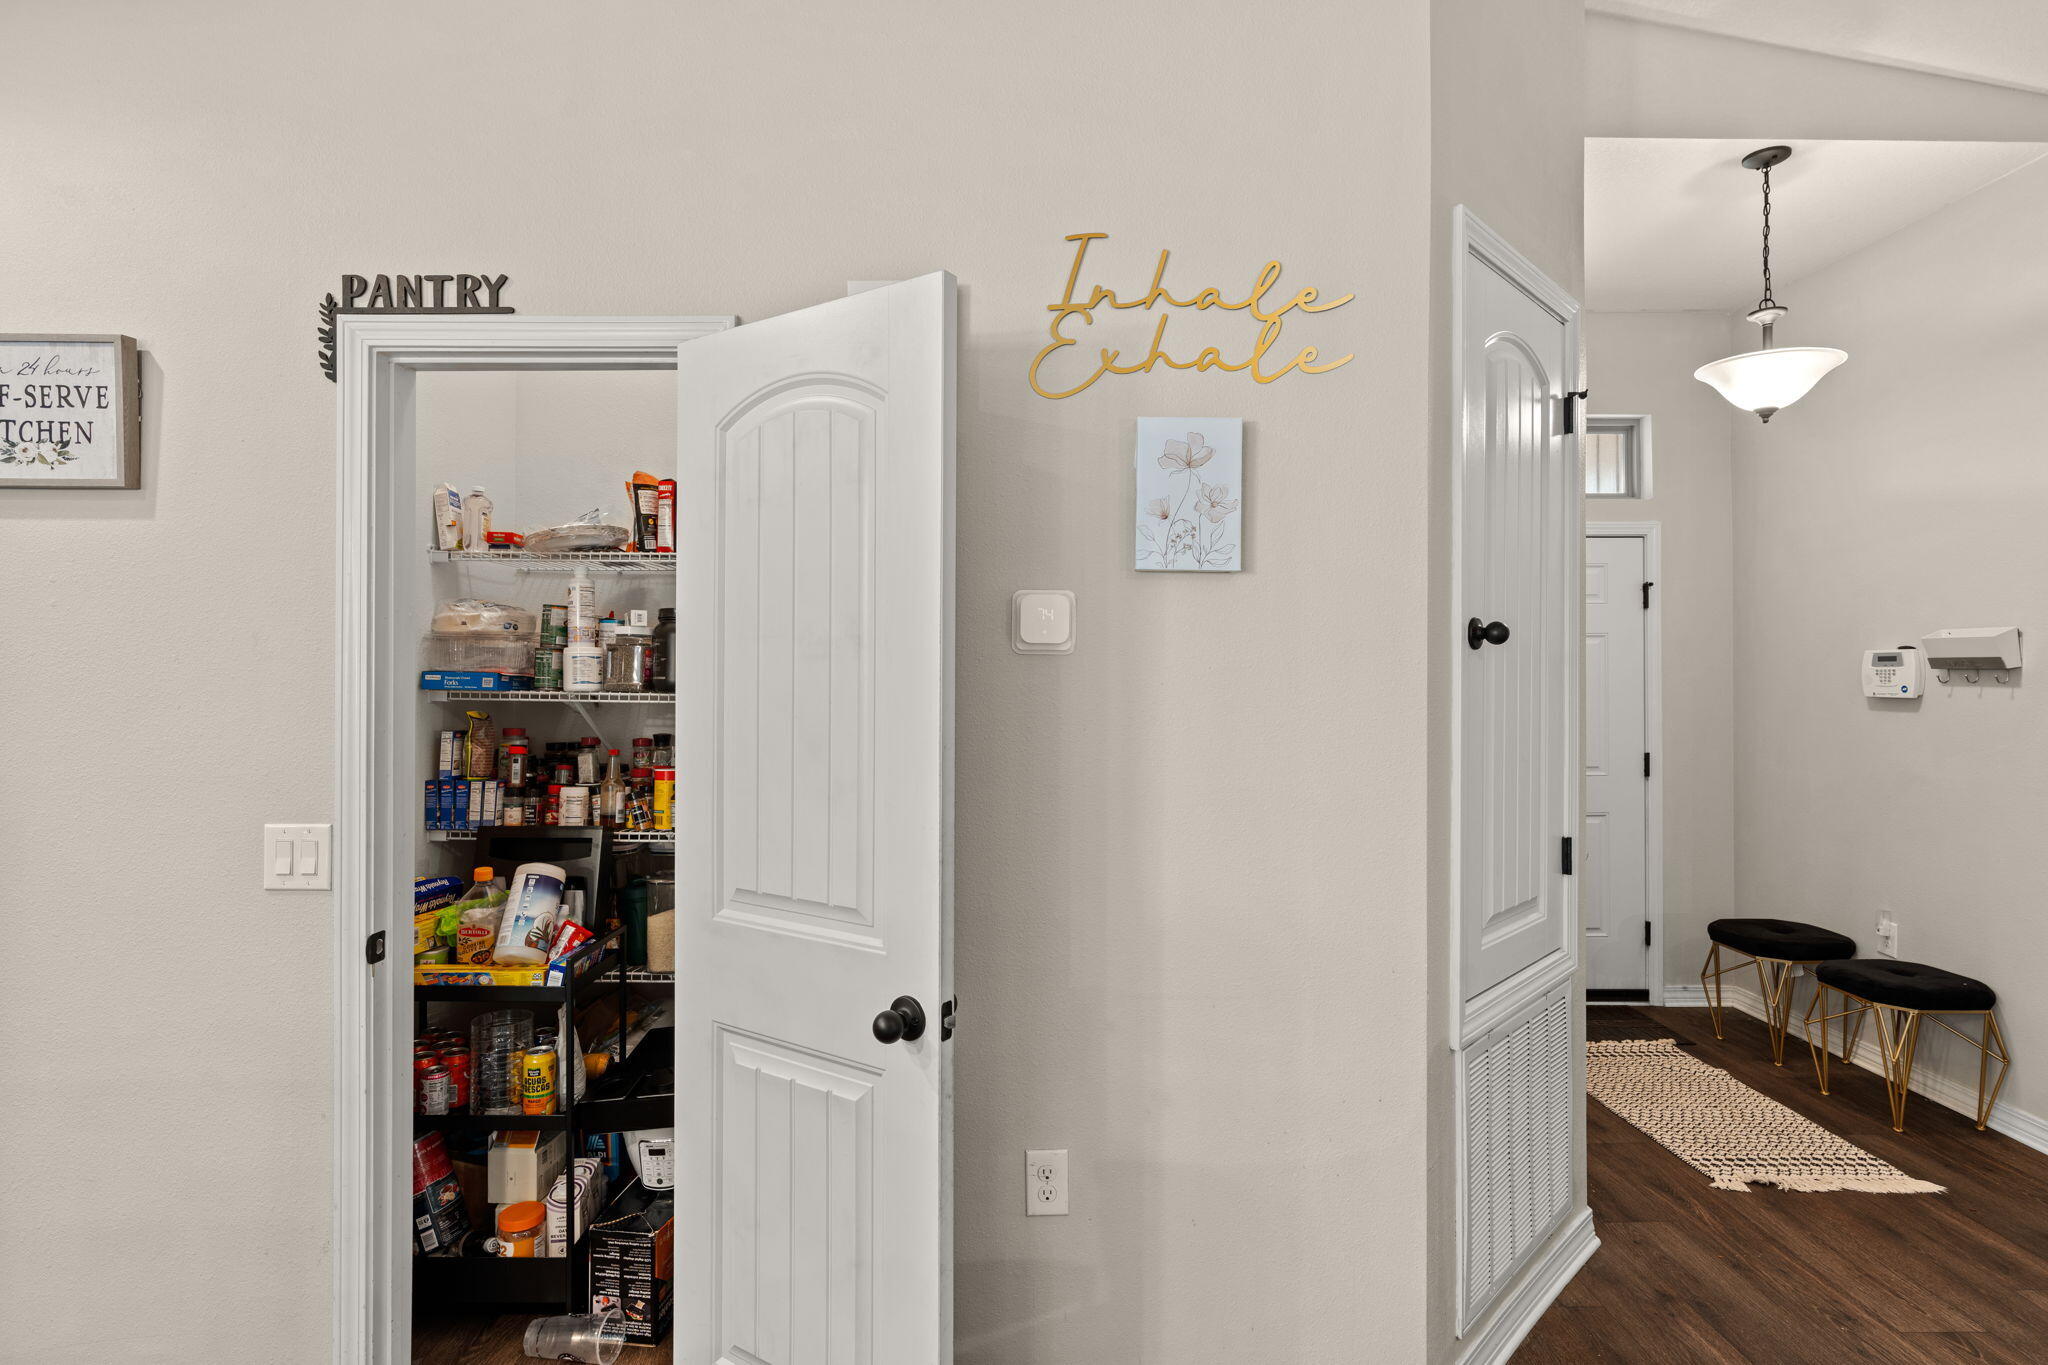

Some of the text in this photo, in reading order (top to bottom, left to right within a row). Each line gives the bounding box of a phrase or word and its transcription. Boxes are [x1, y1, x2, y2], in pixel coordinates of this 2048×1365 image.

[342, 274, 509, 308] PANTRY
[1047, 233, 1355, 320] Inhale
[17, 357, 41, 376] 24
[43, 354, 101, 377] hours
[1029, 308, 1355, 399] Exhale
